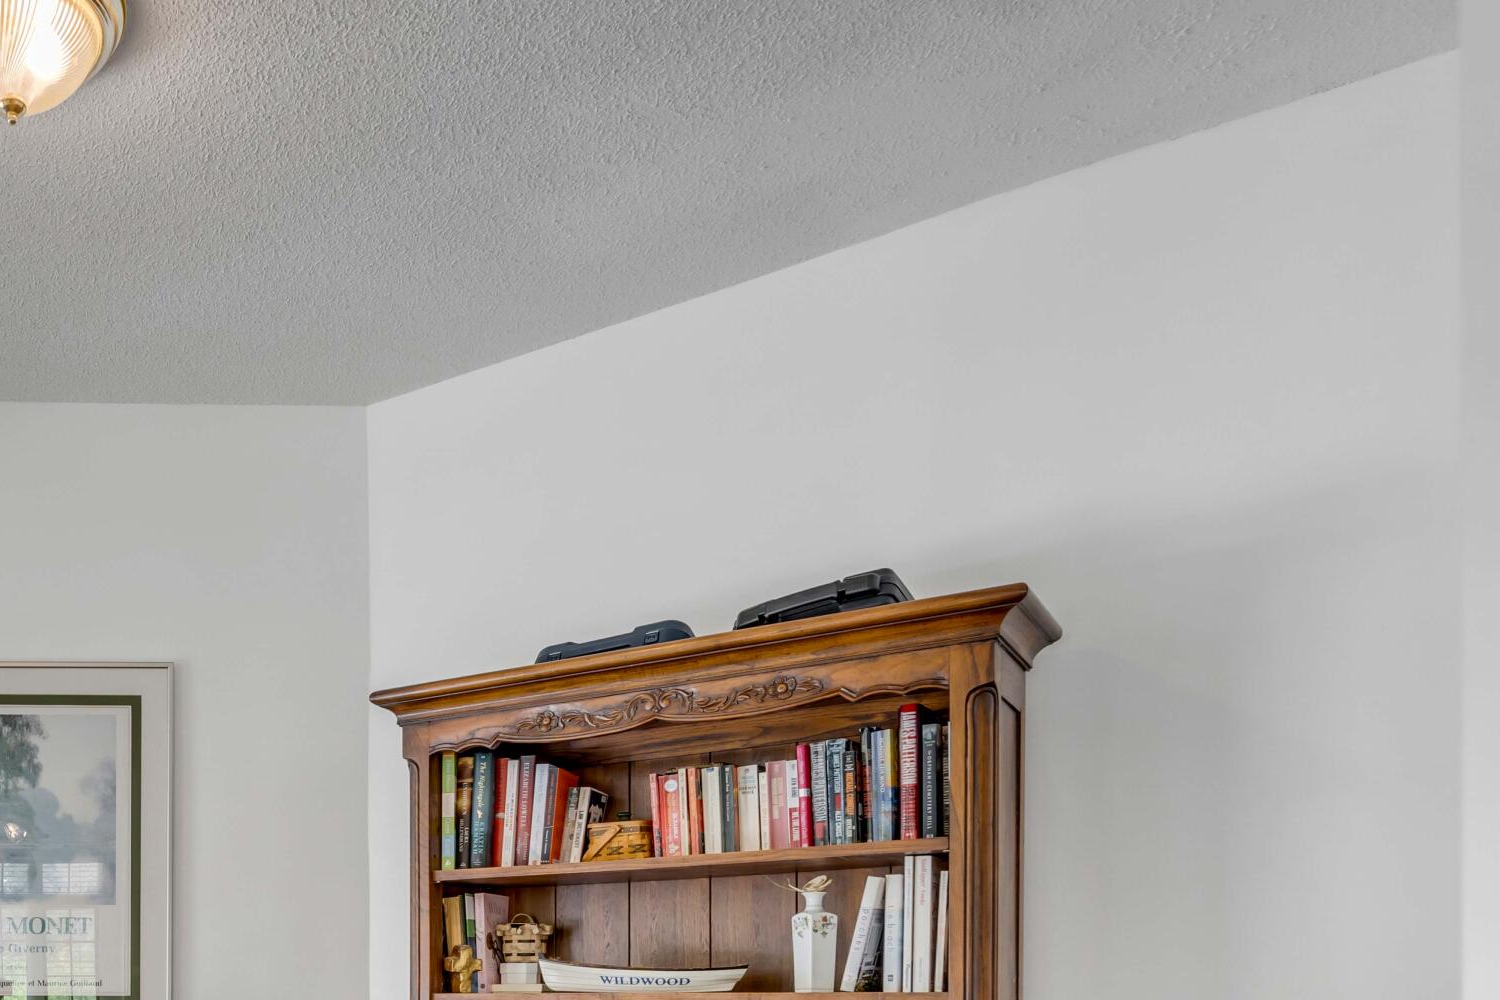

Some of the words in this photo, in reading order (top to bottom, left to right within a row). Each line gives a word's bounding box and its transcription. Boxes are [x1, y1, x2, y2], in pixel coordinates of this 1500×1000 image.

[901, 711, 917, 738] JAMES
[480, 761, 488, 774] The
[812, 755, 825, 779] JAMES
[832, 753, 841, 768] JAMES
[901, 738, 917, 785] PATTERSON
[476, 775, 486, 809] Nightingale
[521, 762, 530, 800] ELIZABETH
[834, 768, 842, 794] PATTERSON
[845, 772, 854, 793] MICHAEL
[813, 779, 827, 823] PATTERSON
[846, 793, 855, 816] CONNELLY
[519, 801, 528, 828] LOWELL
[578, 810, 586, 820] LAW
[835, 810, 843, 822] ALEX
[478, 821, 486, 855] KRISTIN
[573, 821, 583, 849] DICTIONARY
[835, 822, 844, 839] CROSS
[7, 916, 92, 935] MONET
[8, 944, 55, 956] Giverny
[600, 975, 691, 986] WILDWOOD
